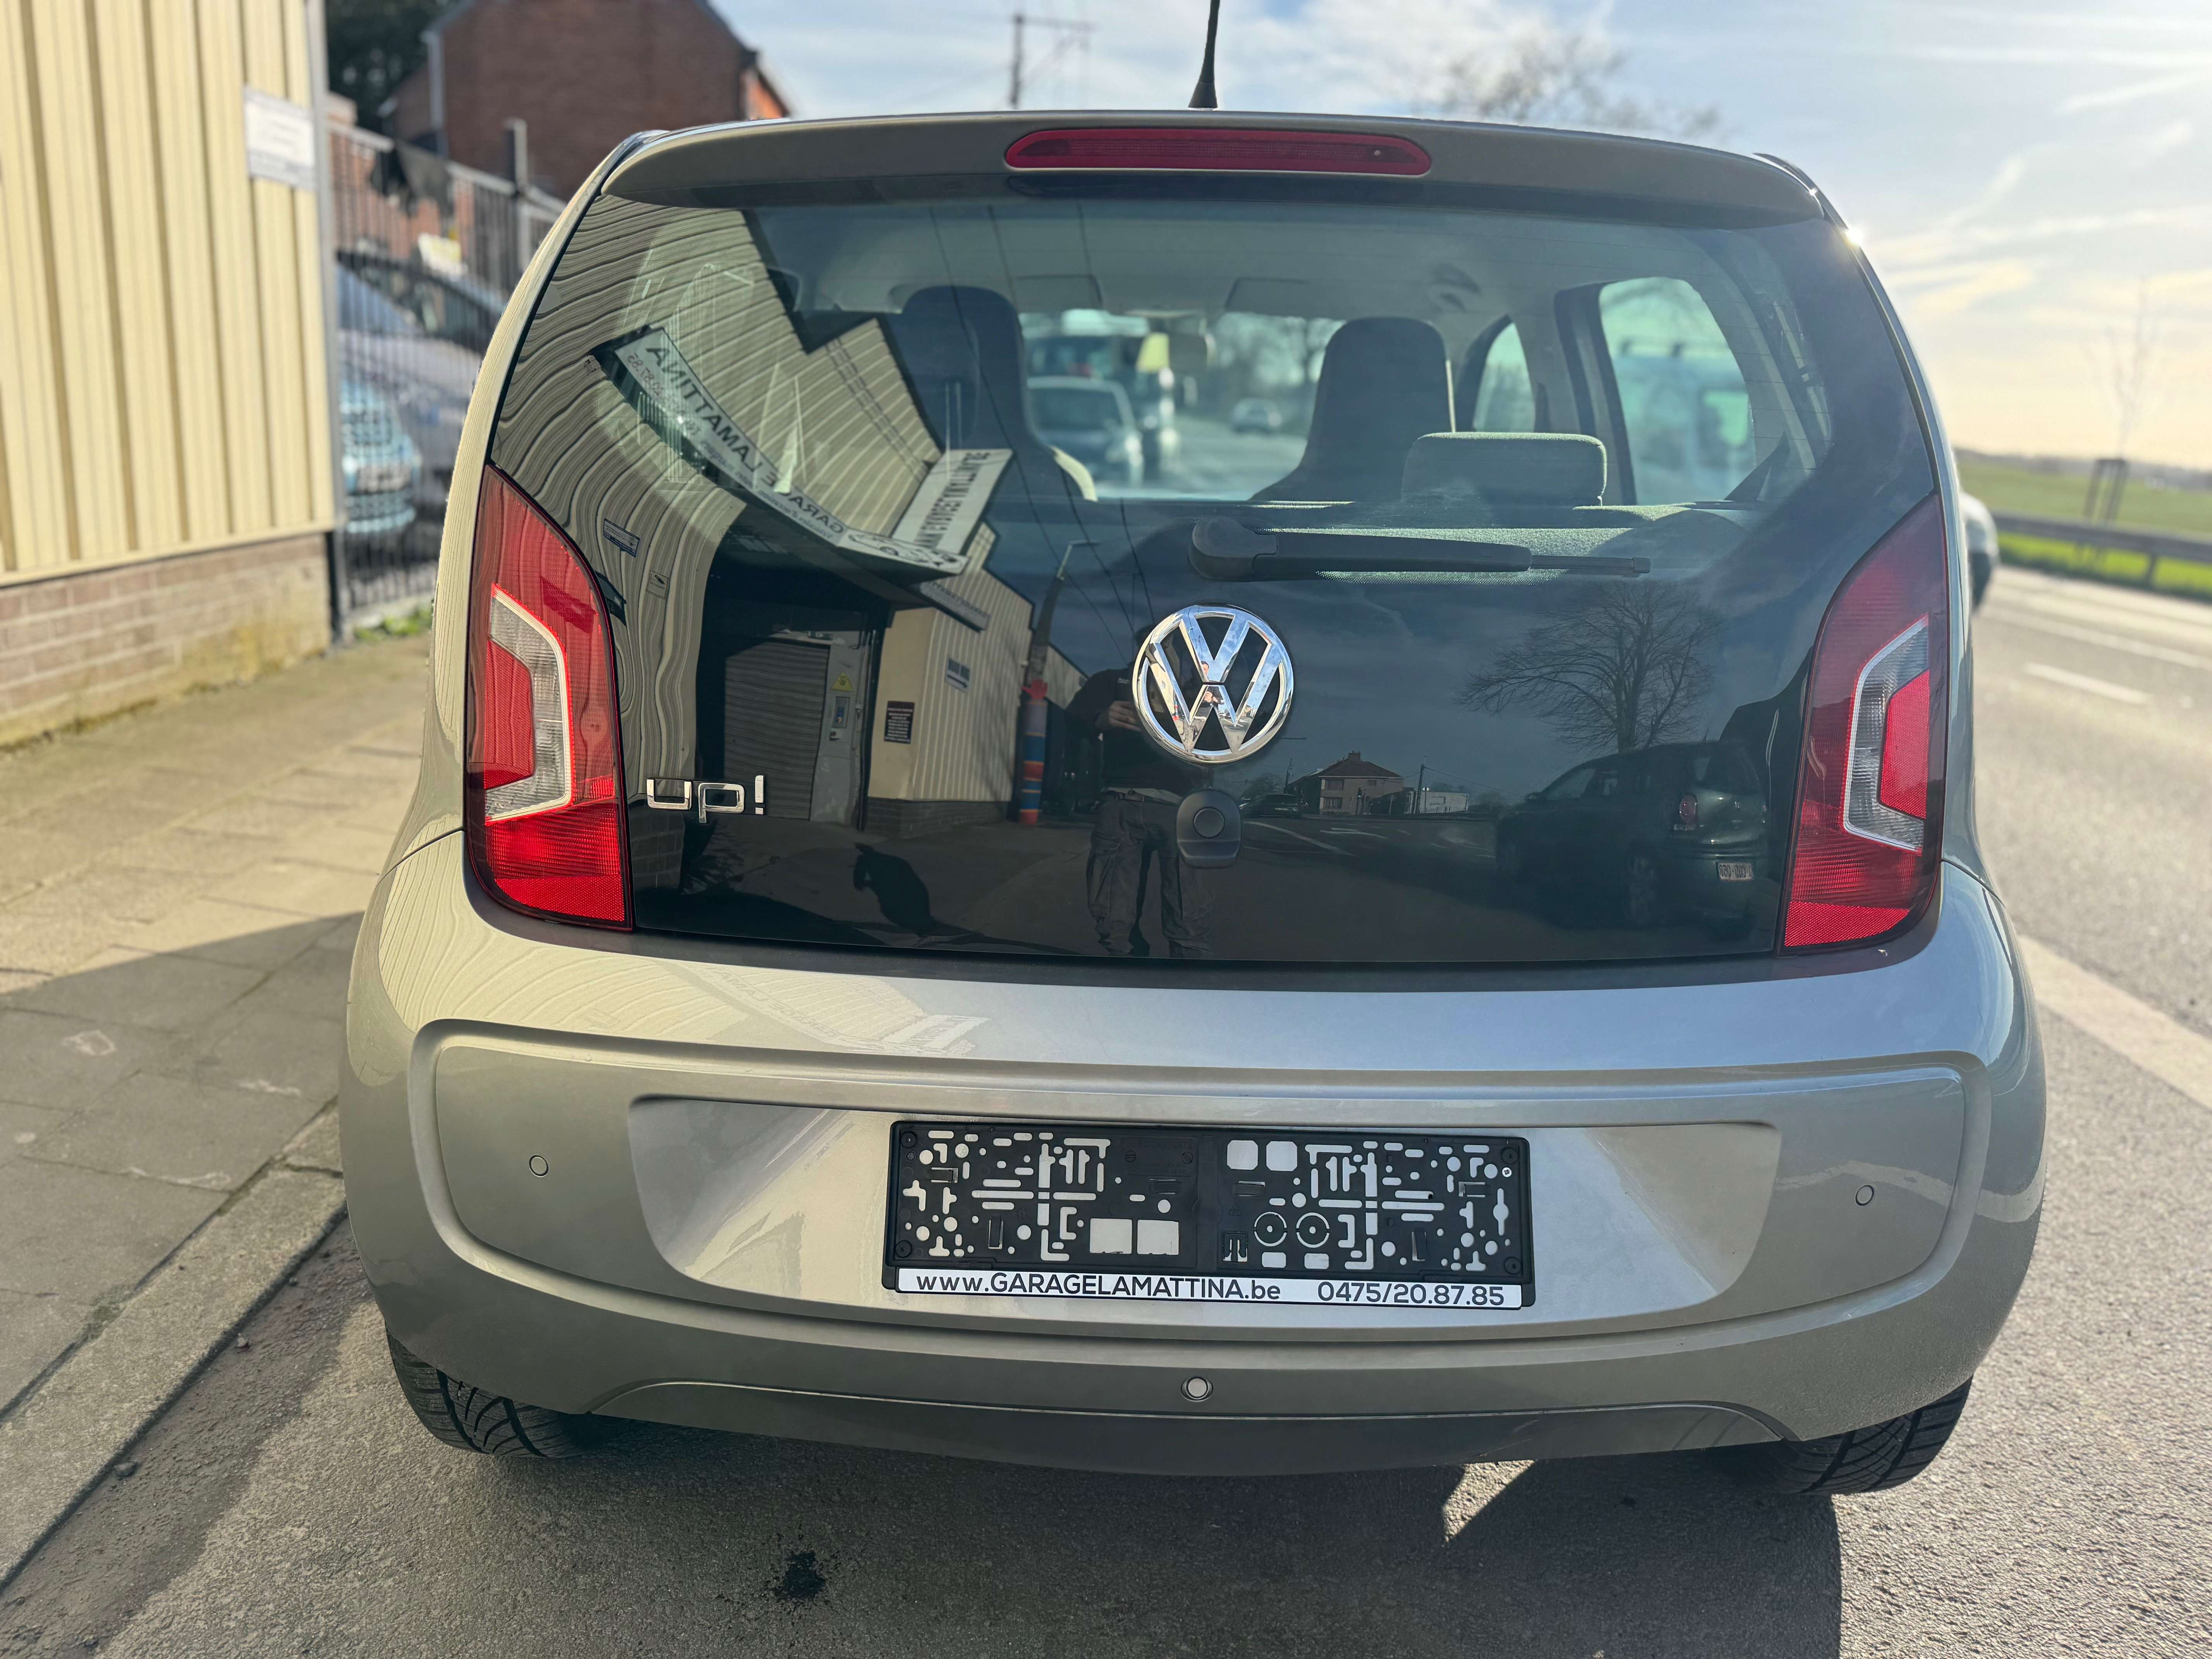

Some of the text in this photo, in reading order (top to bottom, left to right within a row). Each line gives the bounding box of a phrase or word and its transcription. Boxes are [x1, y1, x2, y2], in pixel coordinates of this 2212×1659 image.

[1132, 605, 1294, 764] VW
[646, 775, 764, 823] up!
[916, 1272, 1504, 1306] www.GARAGELAMATTINA.be 0475/20.87.85
